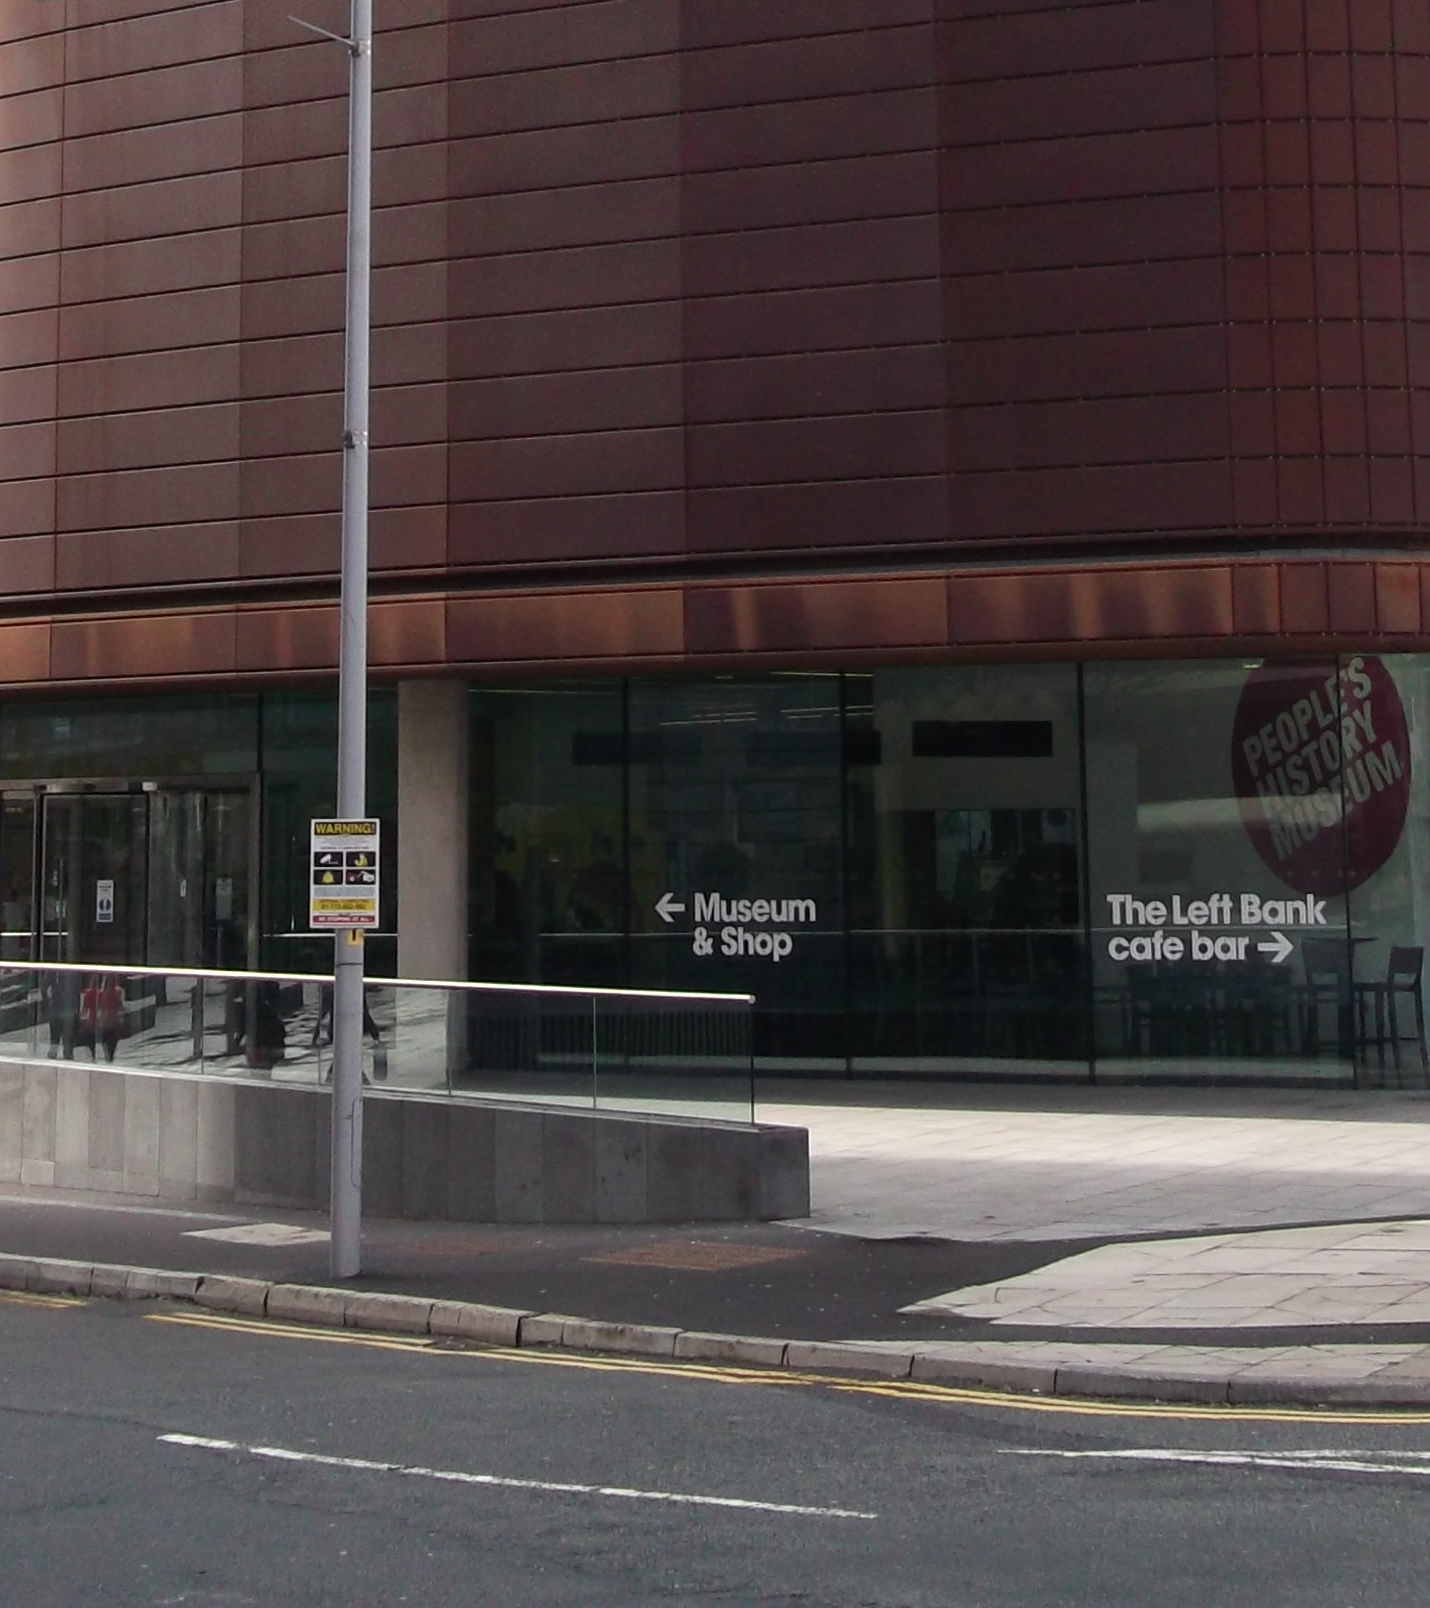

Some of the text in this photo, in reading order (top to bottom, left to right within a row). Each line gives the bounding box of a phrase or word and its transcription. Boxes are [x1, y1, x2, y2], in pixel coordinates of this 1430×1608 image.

[1242, 657, 1402, 861] PEOPLE'S HISTORY MUSEUM
[315, 822, 375, 835] WARNING!
[694, 892, 817, 923] Museum
[1106, 893, 1327, 926] The Left Bank
[692, 926, 793, 963] & Shop
[1107, 929, 1250, 961] cafe bar
